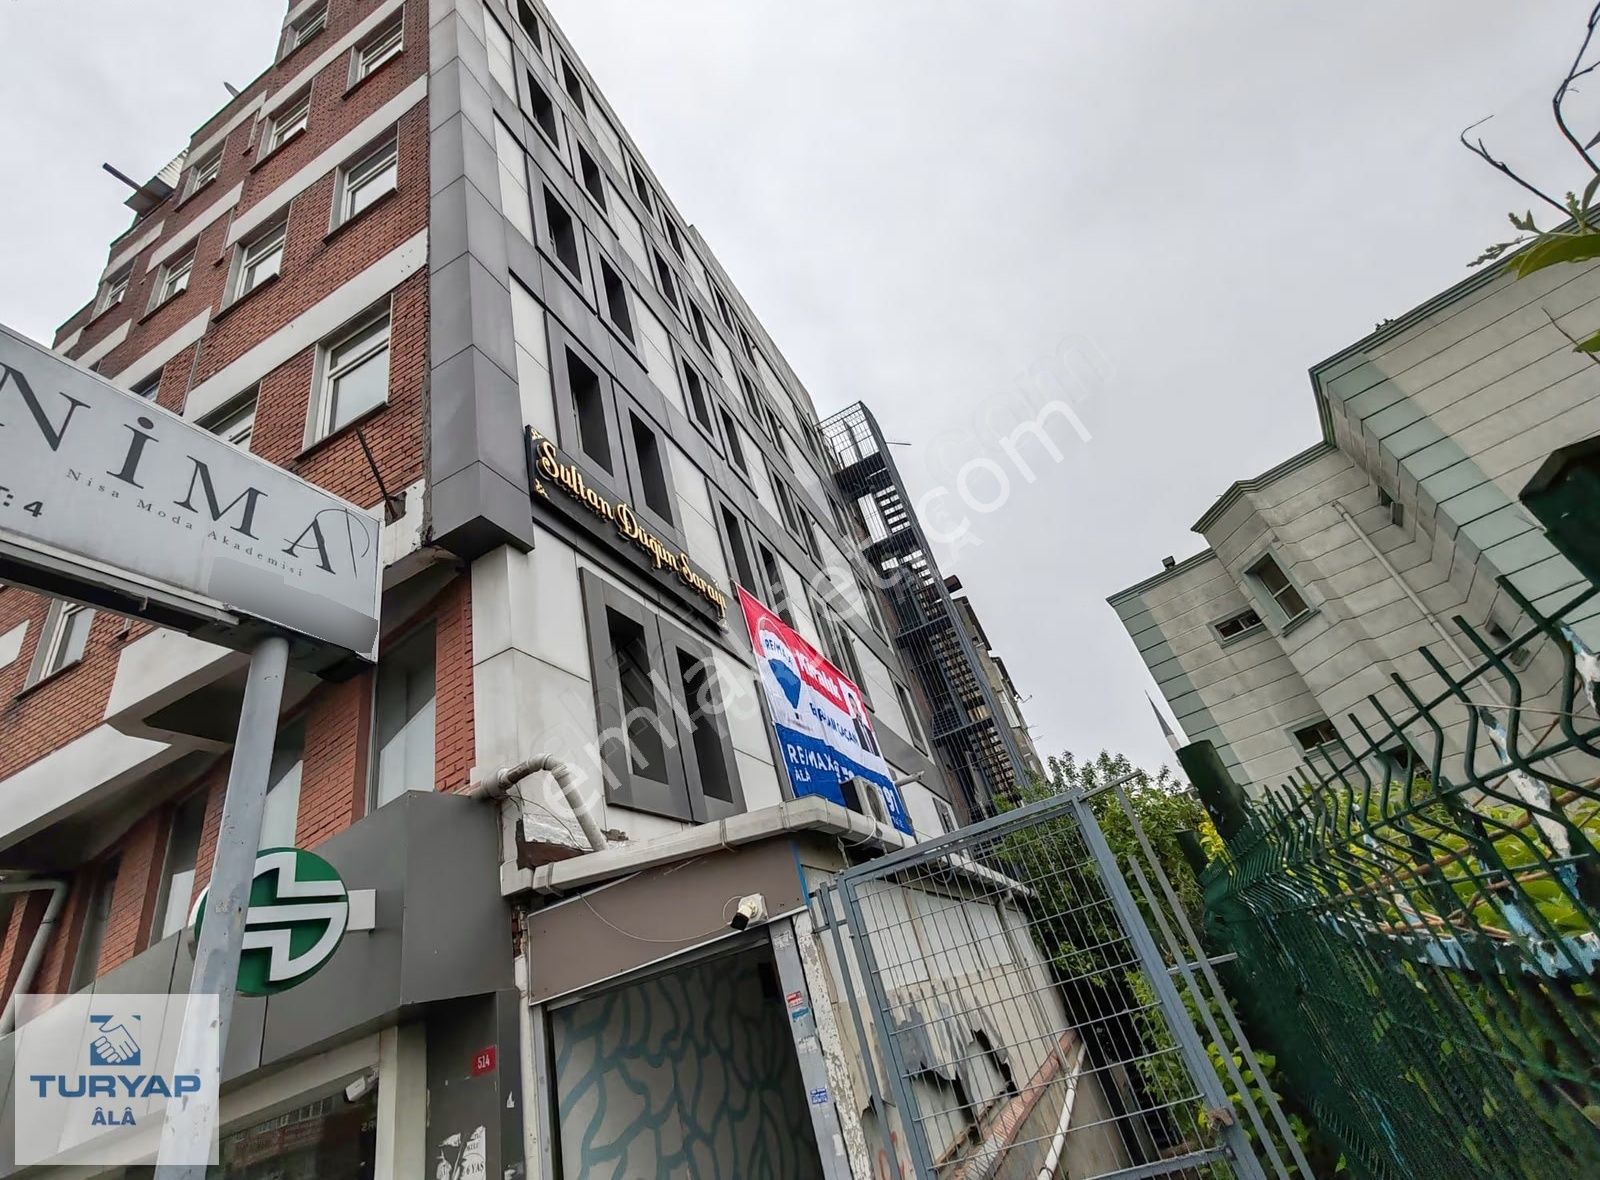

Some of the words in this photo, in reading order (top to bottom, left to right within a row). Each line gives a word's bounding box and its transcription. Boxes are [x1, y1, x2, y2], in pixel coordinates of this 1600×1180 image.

[23, 500, 43, 518] 4
[66, 468, 119, 498] Nisa
[136, 499, 193, 530] Moda
[207, 530, 302, 577] Akademisi
[539, 441, 615, 520] Sultan
[615, 503, 679, 569] Düğün
[678, 552, 727, 618] Sarayı
[787, 743, 835, 771] RE/MAX
[477, 1054, 490, 1069] 514
